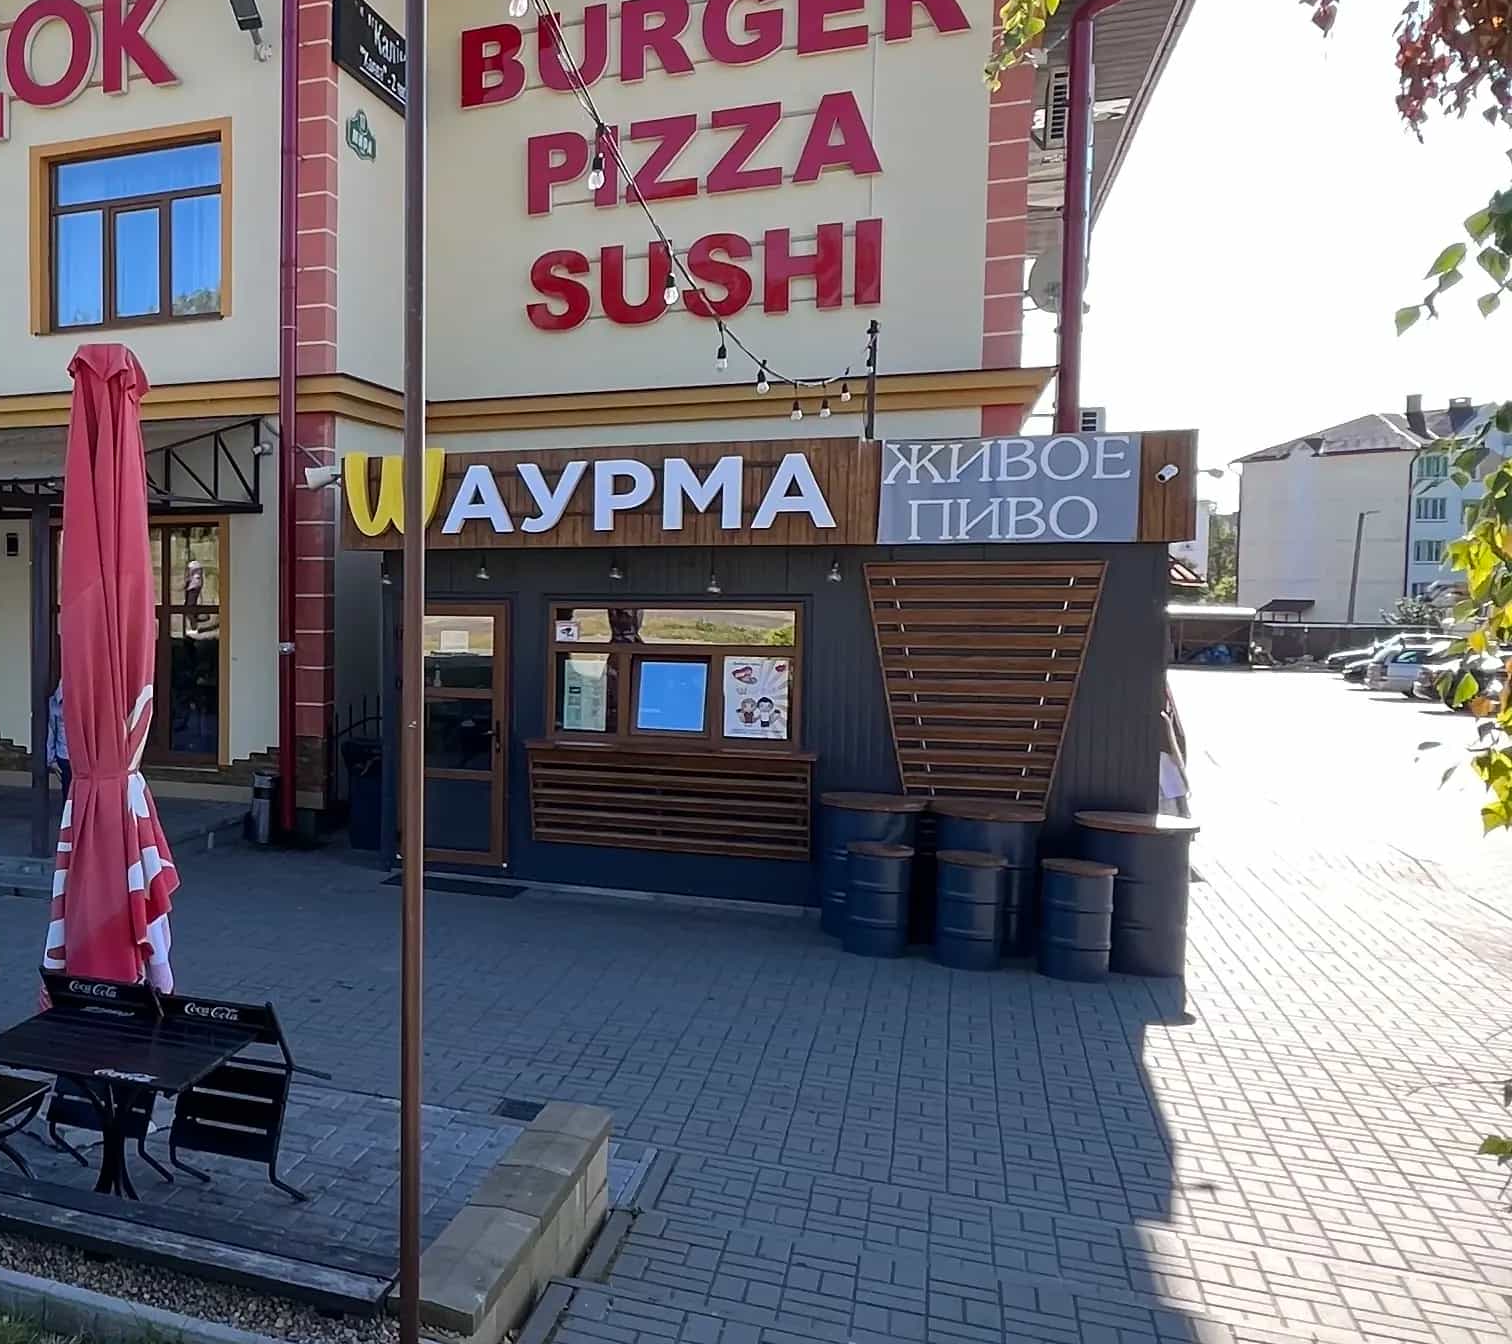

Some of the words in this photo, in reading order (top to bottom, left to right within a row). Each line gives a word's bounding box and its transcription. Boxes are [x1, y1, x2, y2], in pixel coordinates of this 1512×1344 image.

[527, 90, 883, 217] PIZZA
[526, 218, 884, 331] SUSHI
[883, 435, 1131, 485] ЖИВОЕ
[907, 495, 1098, 541] ПИВО
